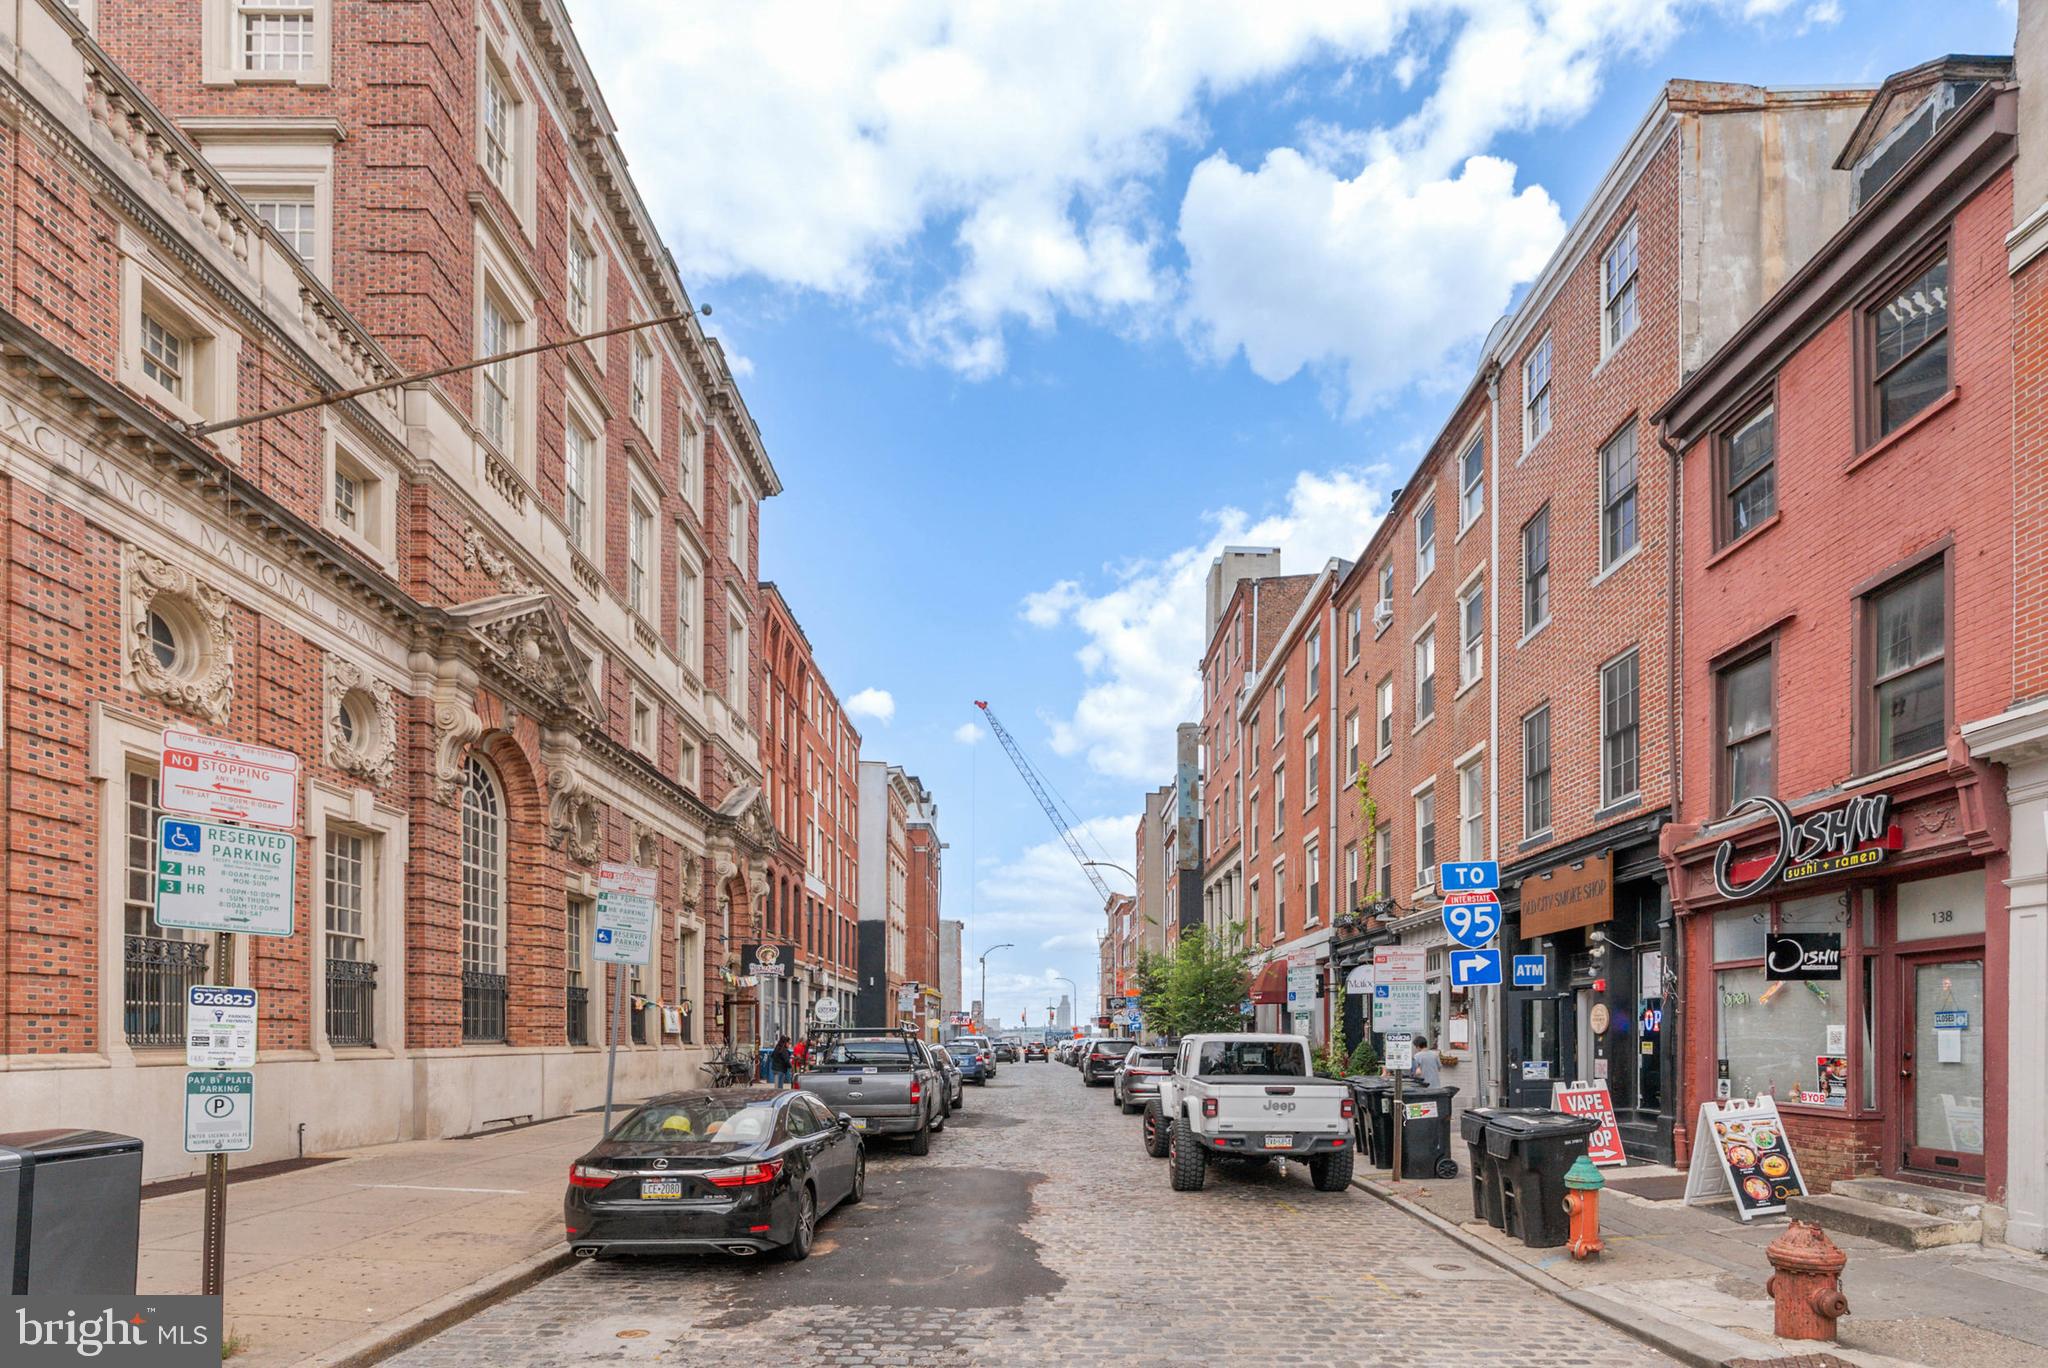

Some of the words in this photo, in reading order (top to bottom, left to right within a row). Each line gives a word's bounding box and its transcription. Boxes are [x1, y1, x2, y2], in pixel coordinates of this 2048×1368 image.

[0, 403, 178, 533] XCHANGE
[200, 523, 323, 619] NATIONAL
[336, 604, 385, 655] BANK
[171, 754, 193, 767] NO
[202, 760, 271, 782] STOPPING
[215, 775, 230, 783] ANY
[208, 828, 287, 849] RESERVED
[1714, 794, 1889, 899] OISHII
[212, 844, 282, 865] PARKING
[167, 863, 175, 874] 2
[187, 865, 206, 876] HR
[1787, 860, 1818, 879] sushi
[1822, 861, 1830, 870] +
[1835, 851, 1877, 869] ramen
[1455, 867, 1484, 885] TO
[165, 881, 175, 892] 3
[186, 883, 205, 895] HR
[621, 895, 647, 905] PARKING
[1451, 894, 1491, 903] INTERSTATE
[1537, 894, 1553, 912] CITY
[1554, 887, 1582, 907] SMOKE
[1583, 880, 1606, 899] SHOP
[619, 908, 646, 917] PARKING
[1931, 910, 1953, 924] 138
[1450, 906, 1495, 938] 95
[613, 931, 647, 940] RESERVED
[614, 938, 645, 947] PARKING
[1768, 938, 1839, 973] OISHII
[1516, 964, 1543, 977] ATM
[194, 992, 254, 1006] 926825
[1936, 1014, 1954, 1023] CLOSED
[188, 1076, 206, 1084] PAY
[210, 1076, 221, 1084] BY
[225, 1076, 252, 1084] PLATE
[199, 1085, 240, 1093] PARKING
[1566, 1093, 1604, 1112] VAPE
[1801, 1093, 1825, 1103] BYOB
[214, 1098, 224, 1114] P
[1263, 1100, 1296, 1113] Jeep
[1589, 1130, 1613, 1148] HOP
